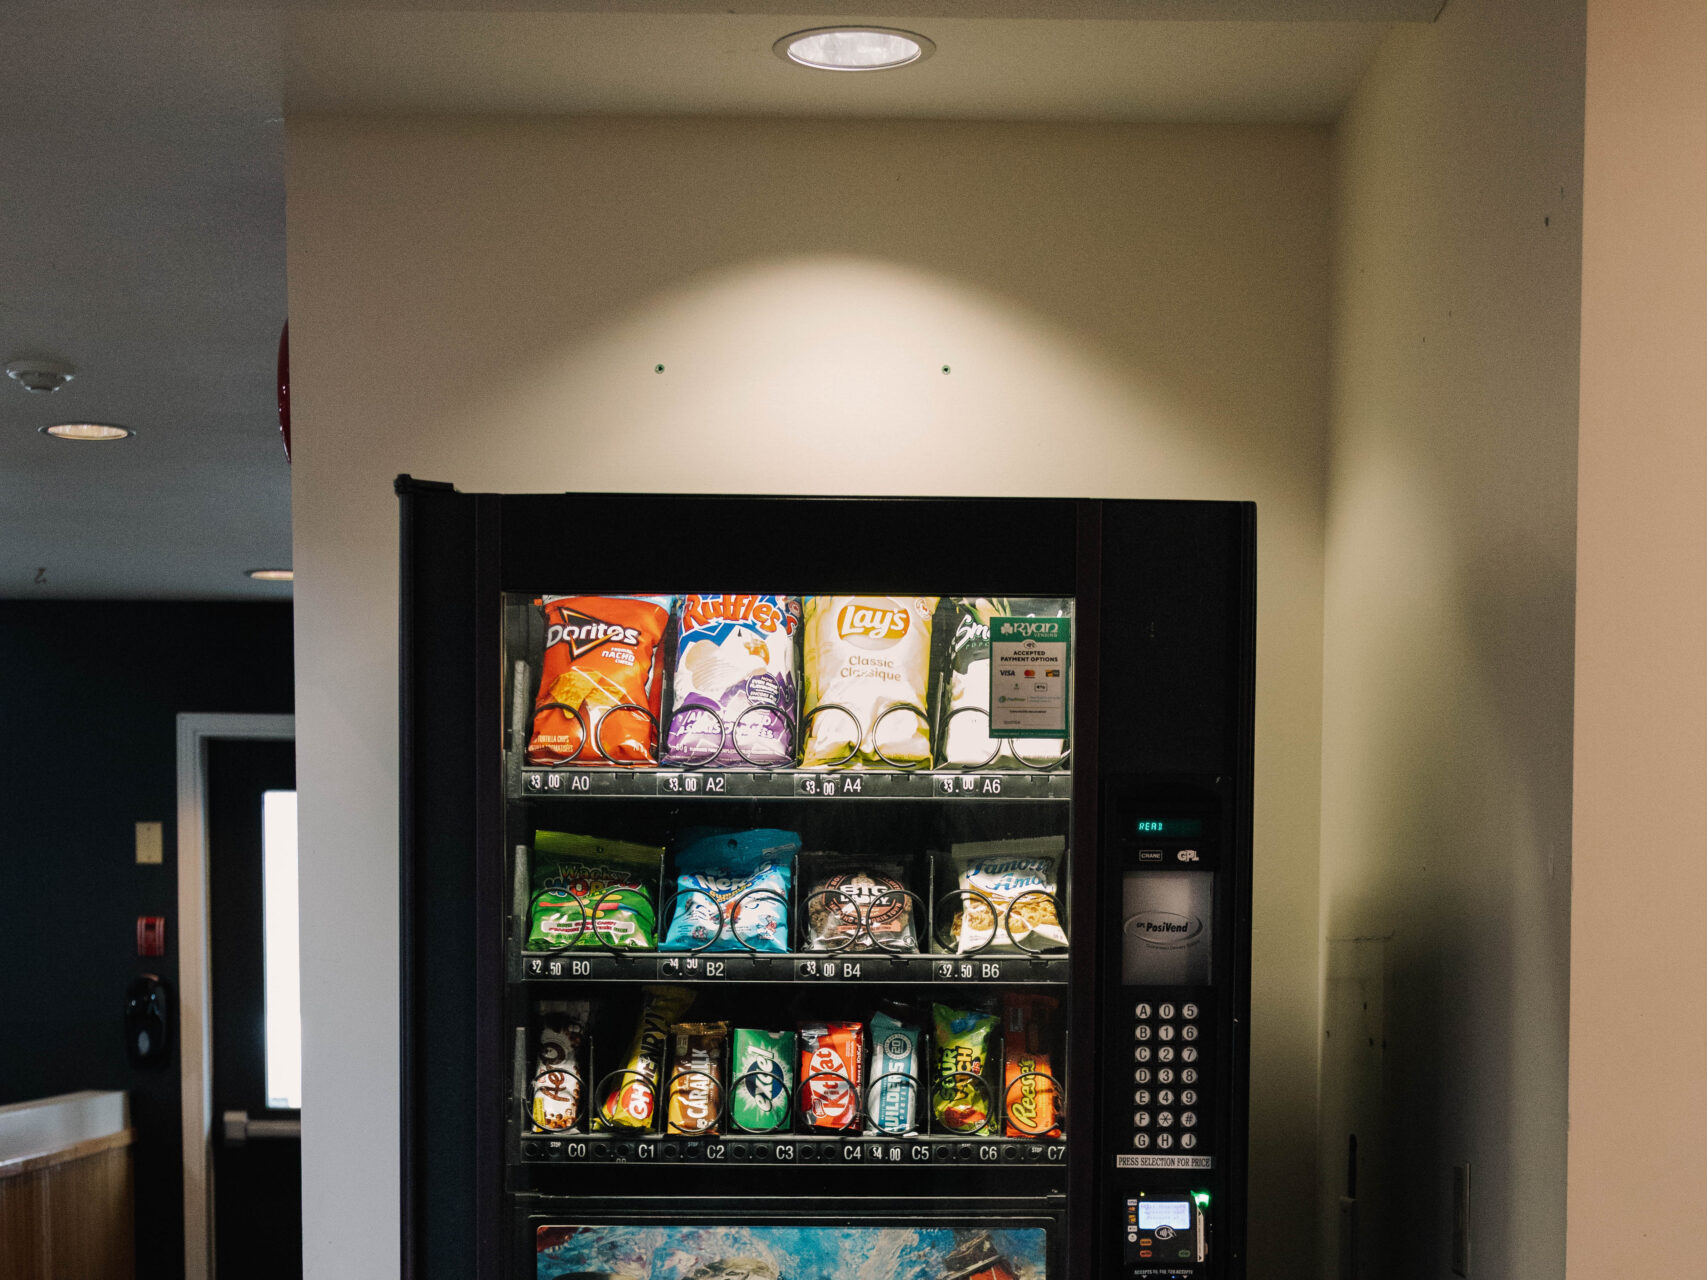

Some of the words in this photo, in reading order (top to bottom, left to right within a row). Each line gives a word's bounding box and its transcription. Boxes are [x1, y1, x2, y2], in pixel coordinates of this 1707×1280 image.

[683, 594, 781, 633] Ruffles
[841, 606, 907, 639] Lay's
[1013, 622, 1059, 637] Ryan
[546, 623, 639, 648] Doritos
[849, 656, 894, 668] Classic
[571, 775, 590, 791] A0
[669, 777, 697, 792] $3.00
[705, 777, 724, 792] A2
[805, 780, 835, 795] $3.00
[843, 779, 862, 792] A4
[982, 779, 1001, 793] A6
[1176, 850, 1200, 862] GPL
[1146, 922, 1189, 933] PosiVend
[532, 959, 562, 976] $2.50
[572, 961, 590, 975] B0
[706, 962, 724, 976] B2
[806, 961, 835, 977] $3.00
[843, 963, 861, 978] B4
[942, 964, 972, 978] $2.50
[982, 964, 1000, 978] B6
[1140, 1005, 1148, 1017] A
[1186, 1005, 1194, 1017] 5
[1140, 1027, 1147, 1038] B
[1163, 1027, 1169, 1038] 1
[1186, 1027, 1194, 1038] 6
[1139, 1048, 1147, 1060] C
[1162, 1048, 1170, 1060] 2
[1186, 1048, 1194, 1060] 7
[748, 1045, 775, 1112] excel
[1139, 1070, 1147, 1081] D
[1162, 1070, 1170, 1081] 3
[1186, 1070, 1193, 1081] 8
[686, 1048, 709, 1119] CARAMILK
[884, 1061, 905, 1130] UILDERS
[1012, 1057, 1038, 1128] Reese's
[1139, 1092, 1146, 1103] E
[1162, 1092, 1169, 1103] 4
[1185, 1092, 1193, 1103] 9
[1139, 1113, 1146, 1125] F
[1185, 1113, 1194, 1125] #
[1138, 1135, 1146, 1147] G
[1161, 1135, 1169, 1147] H
[1185, 1135, 1192, 1147] J
[568, 1143, 586, 1158] C0
[638, 1144, 655, 1159] C1
[706, 1144, 725, 1159] C2
[776, 1145, 794, 1160] C3
[844, 1145, 862, 1160] C4
[872, 1147, 901, 1161] $4.00
[911, 1145, 930, 1160] C5
[979, 1146, 998, 1160] C6
[1047, 1146, 1066, 1160] C7
[1118, 1156, 1139, 1167] PRESS
[1140, 1157, 1176, 1167] SELECTION
[1177, 1158, 1190, 1167] FOR
[1191, 1158, 1210, 1167] PRICE
